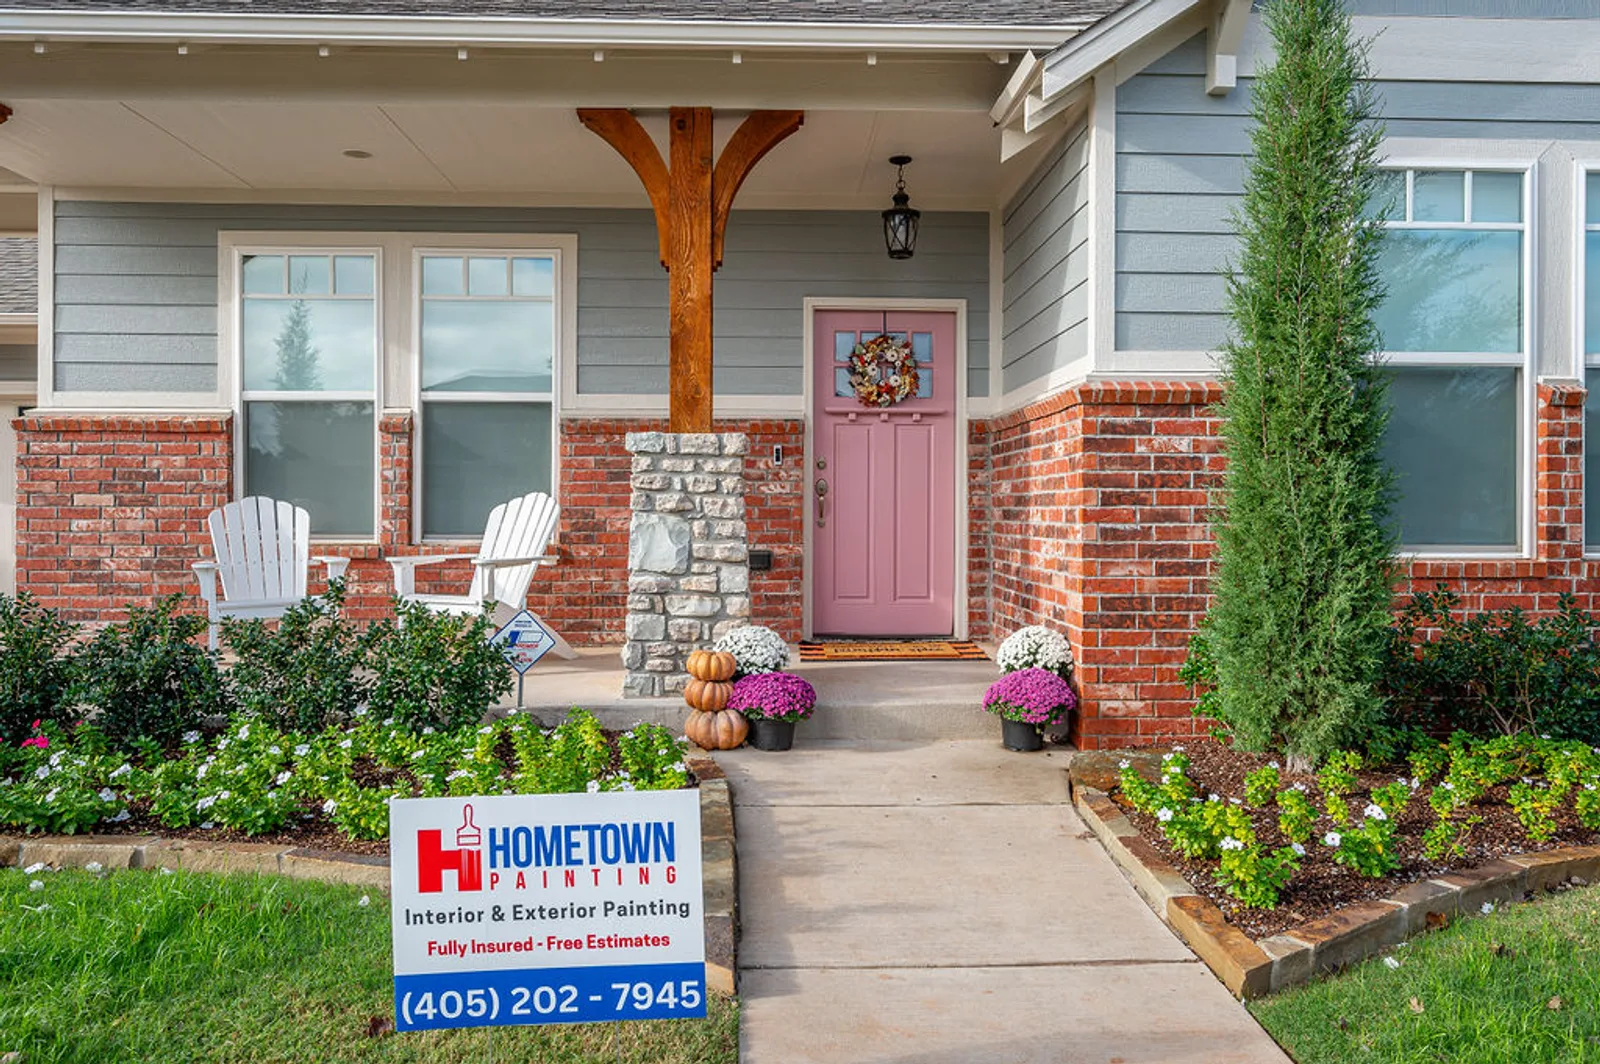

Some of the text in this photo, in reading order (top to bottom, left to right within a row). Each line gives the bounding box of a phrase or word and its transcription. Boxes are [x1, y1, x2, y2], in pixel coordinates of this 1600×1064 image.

[489, 821, 675, 868] HOMETOWN
[490, 866, 676, 890] PAINTING
[405, 900, 690, 926] Interior & Exterior Painting
[428, 939, 467, 957] Fully
[472, 937, 533, 954] Insured
[547, 936, 583, 951] Free
[587, 933, 670, 949] Estimates
[402, 988, 499, 1024] (405)
[510, 985, 579, 1015] 202
[611, 981, 700, 1011] 7945
